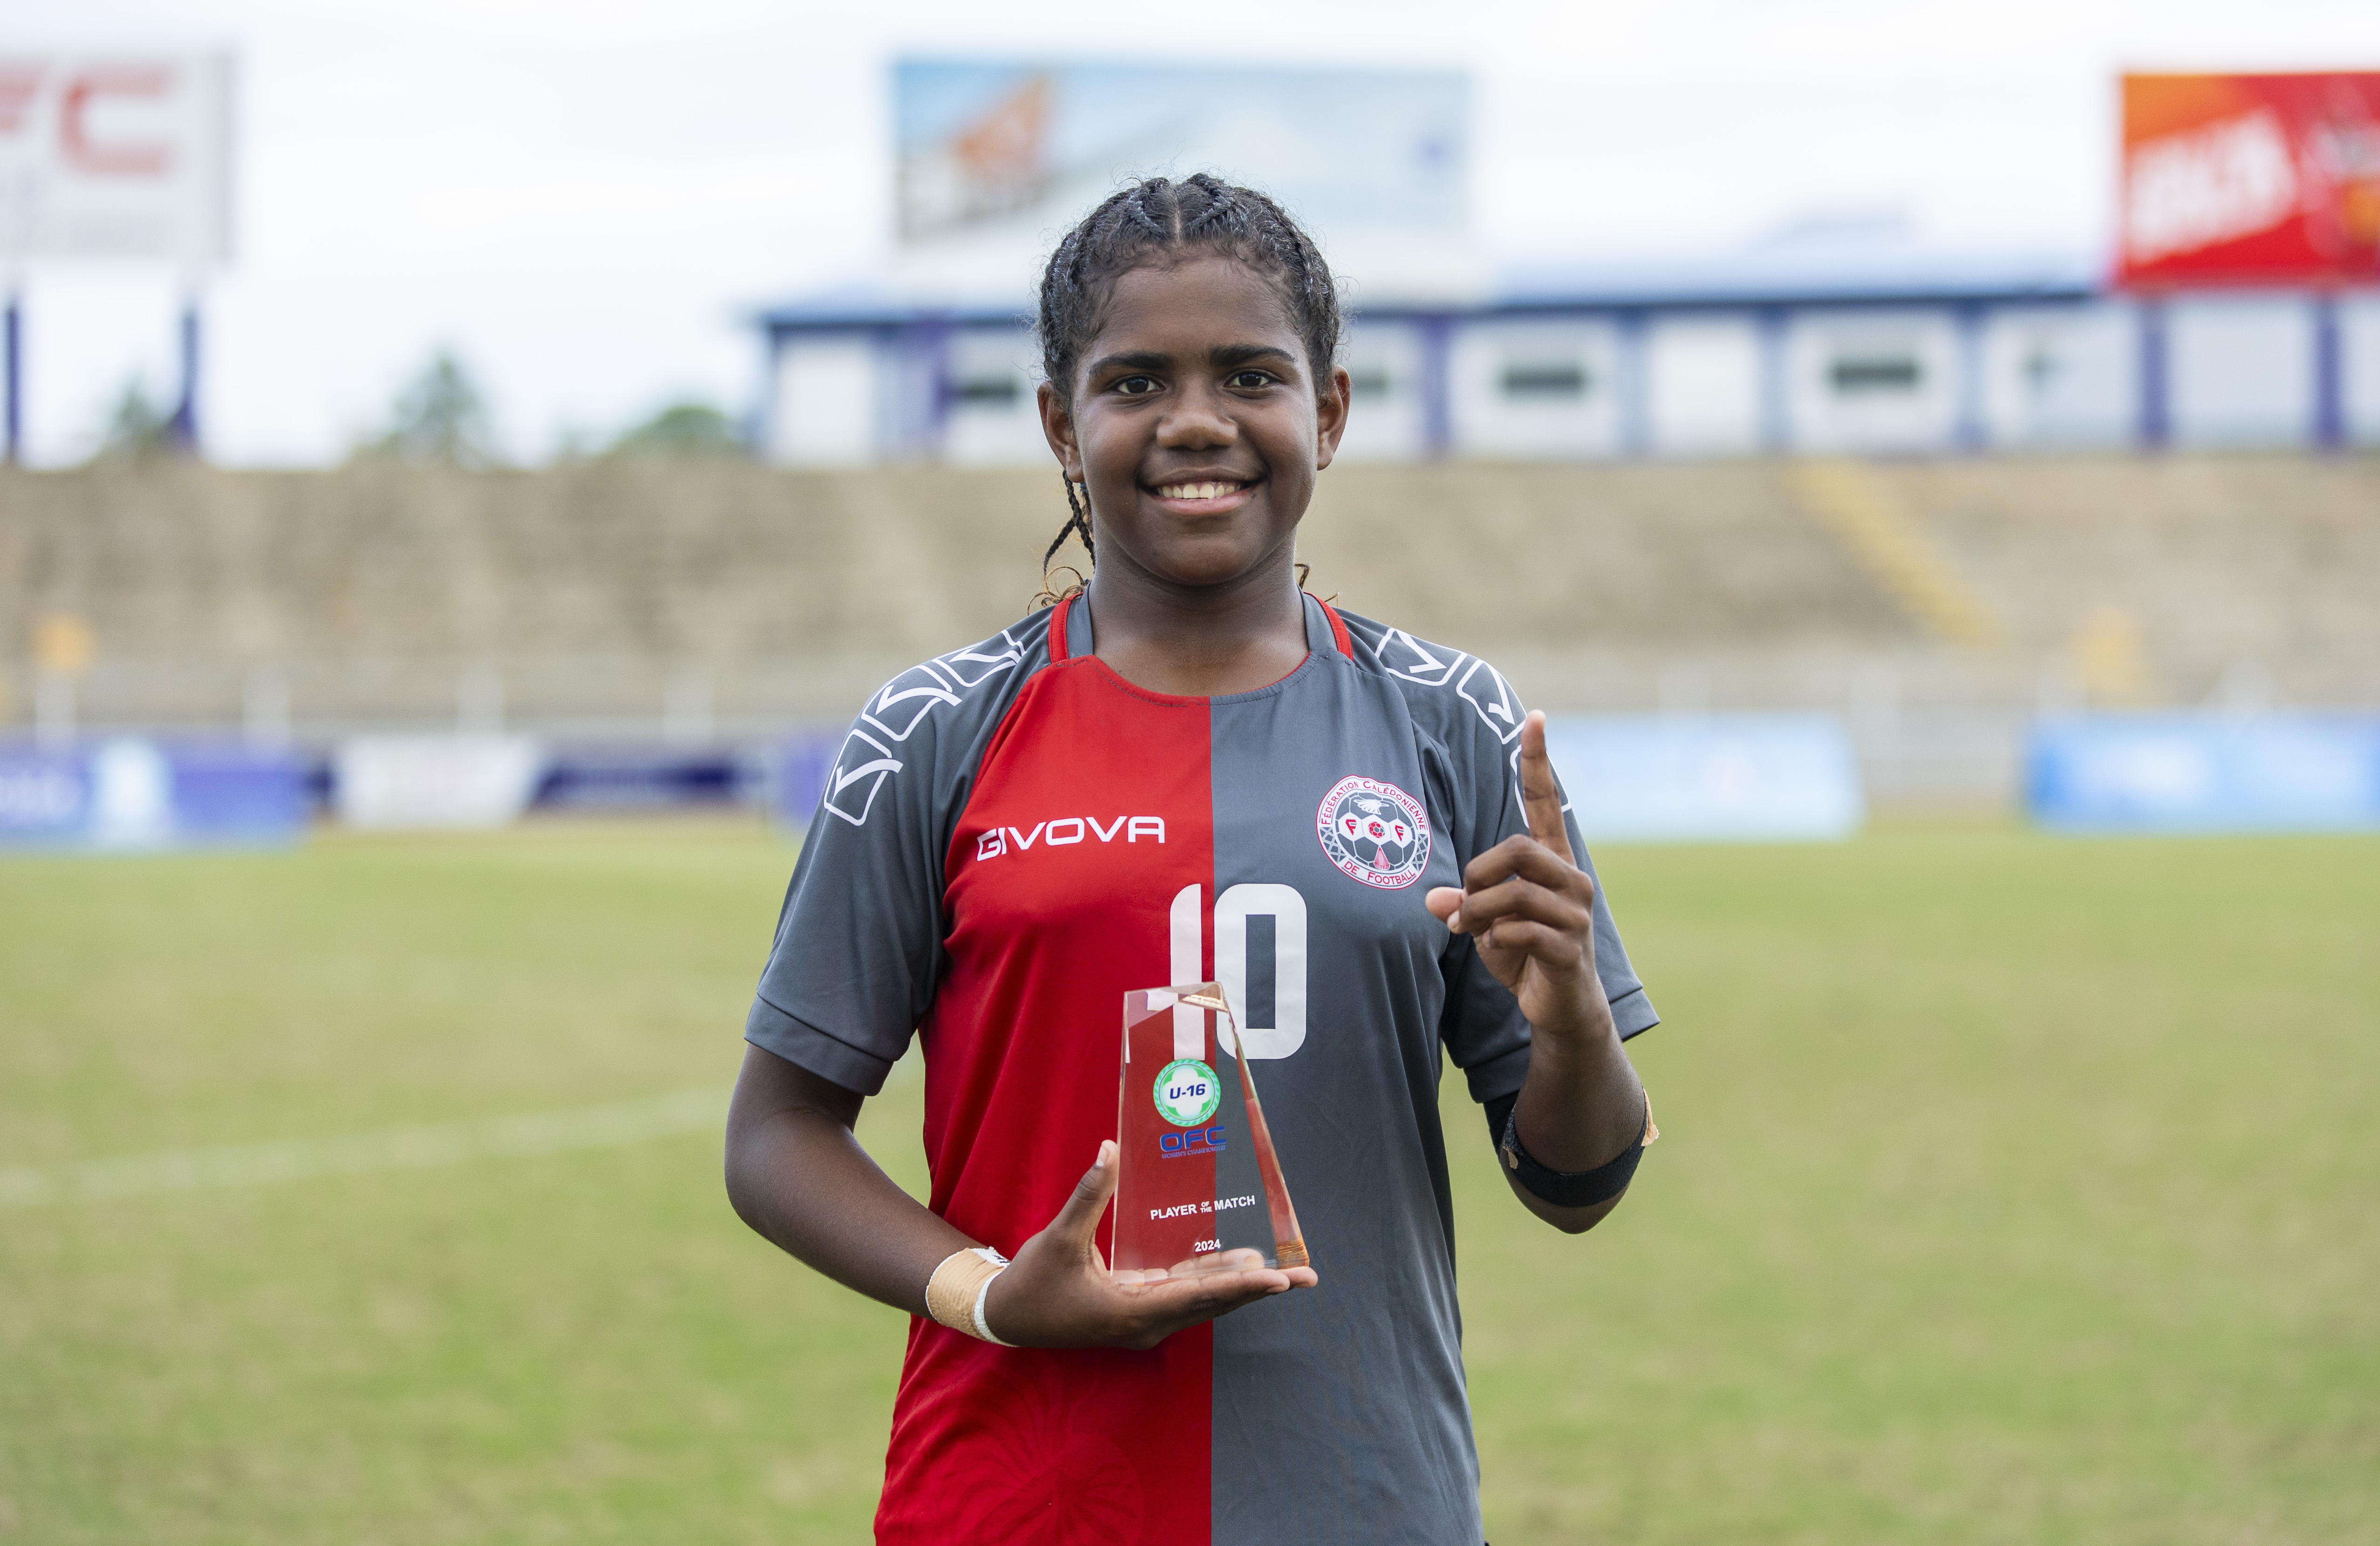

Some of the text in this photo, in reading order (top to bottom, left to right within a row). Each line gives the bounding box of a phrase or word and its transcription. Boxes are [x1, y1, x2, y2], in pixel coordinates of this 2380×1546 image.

[977, 816, 1165, 861] GIVOVA
[1344, 861, 1416, 884] DE FOOTBALL
[1170, 883, 1307, 1060] 10
[1170, 1084, 1206, 1099] U-16
[1160, 1126, 1226, 1152] OFC
[1150, 1204, 1197, 1220] PLAYER
[1214, 1195, 1256, 1211] MATCH
[1195, 1239, 1221, 1252] 2024
